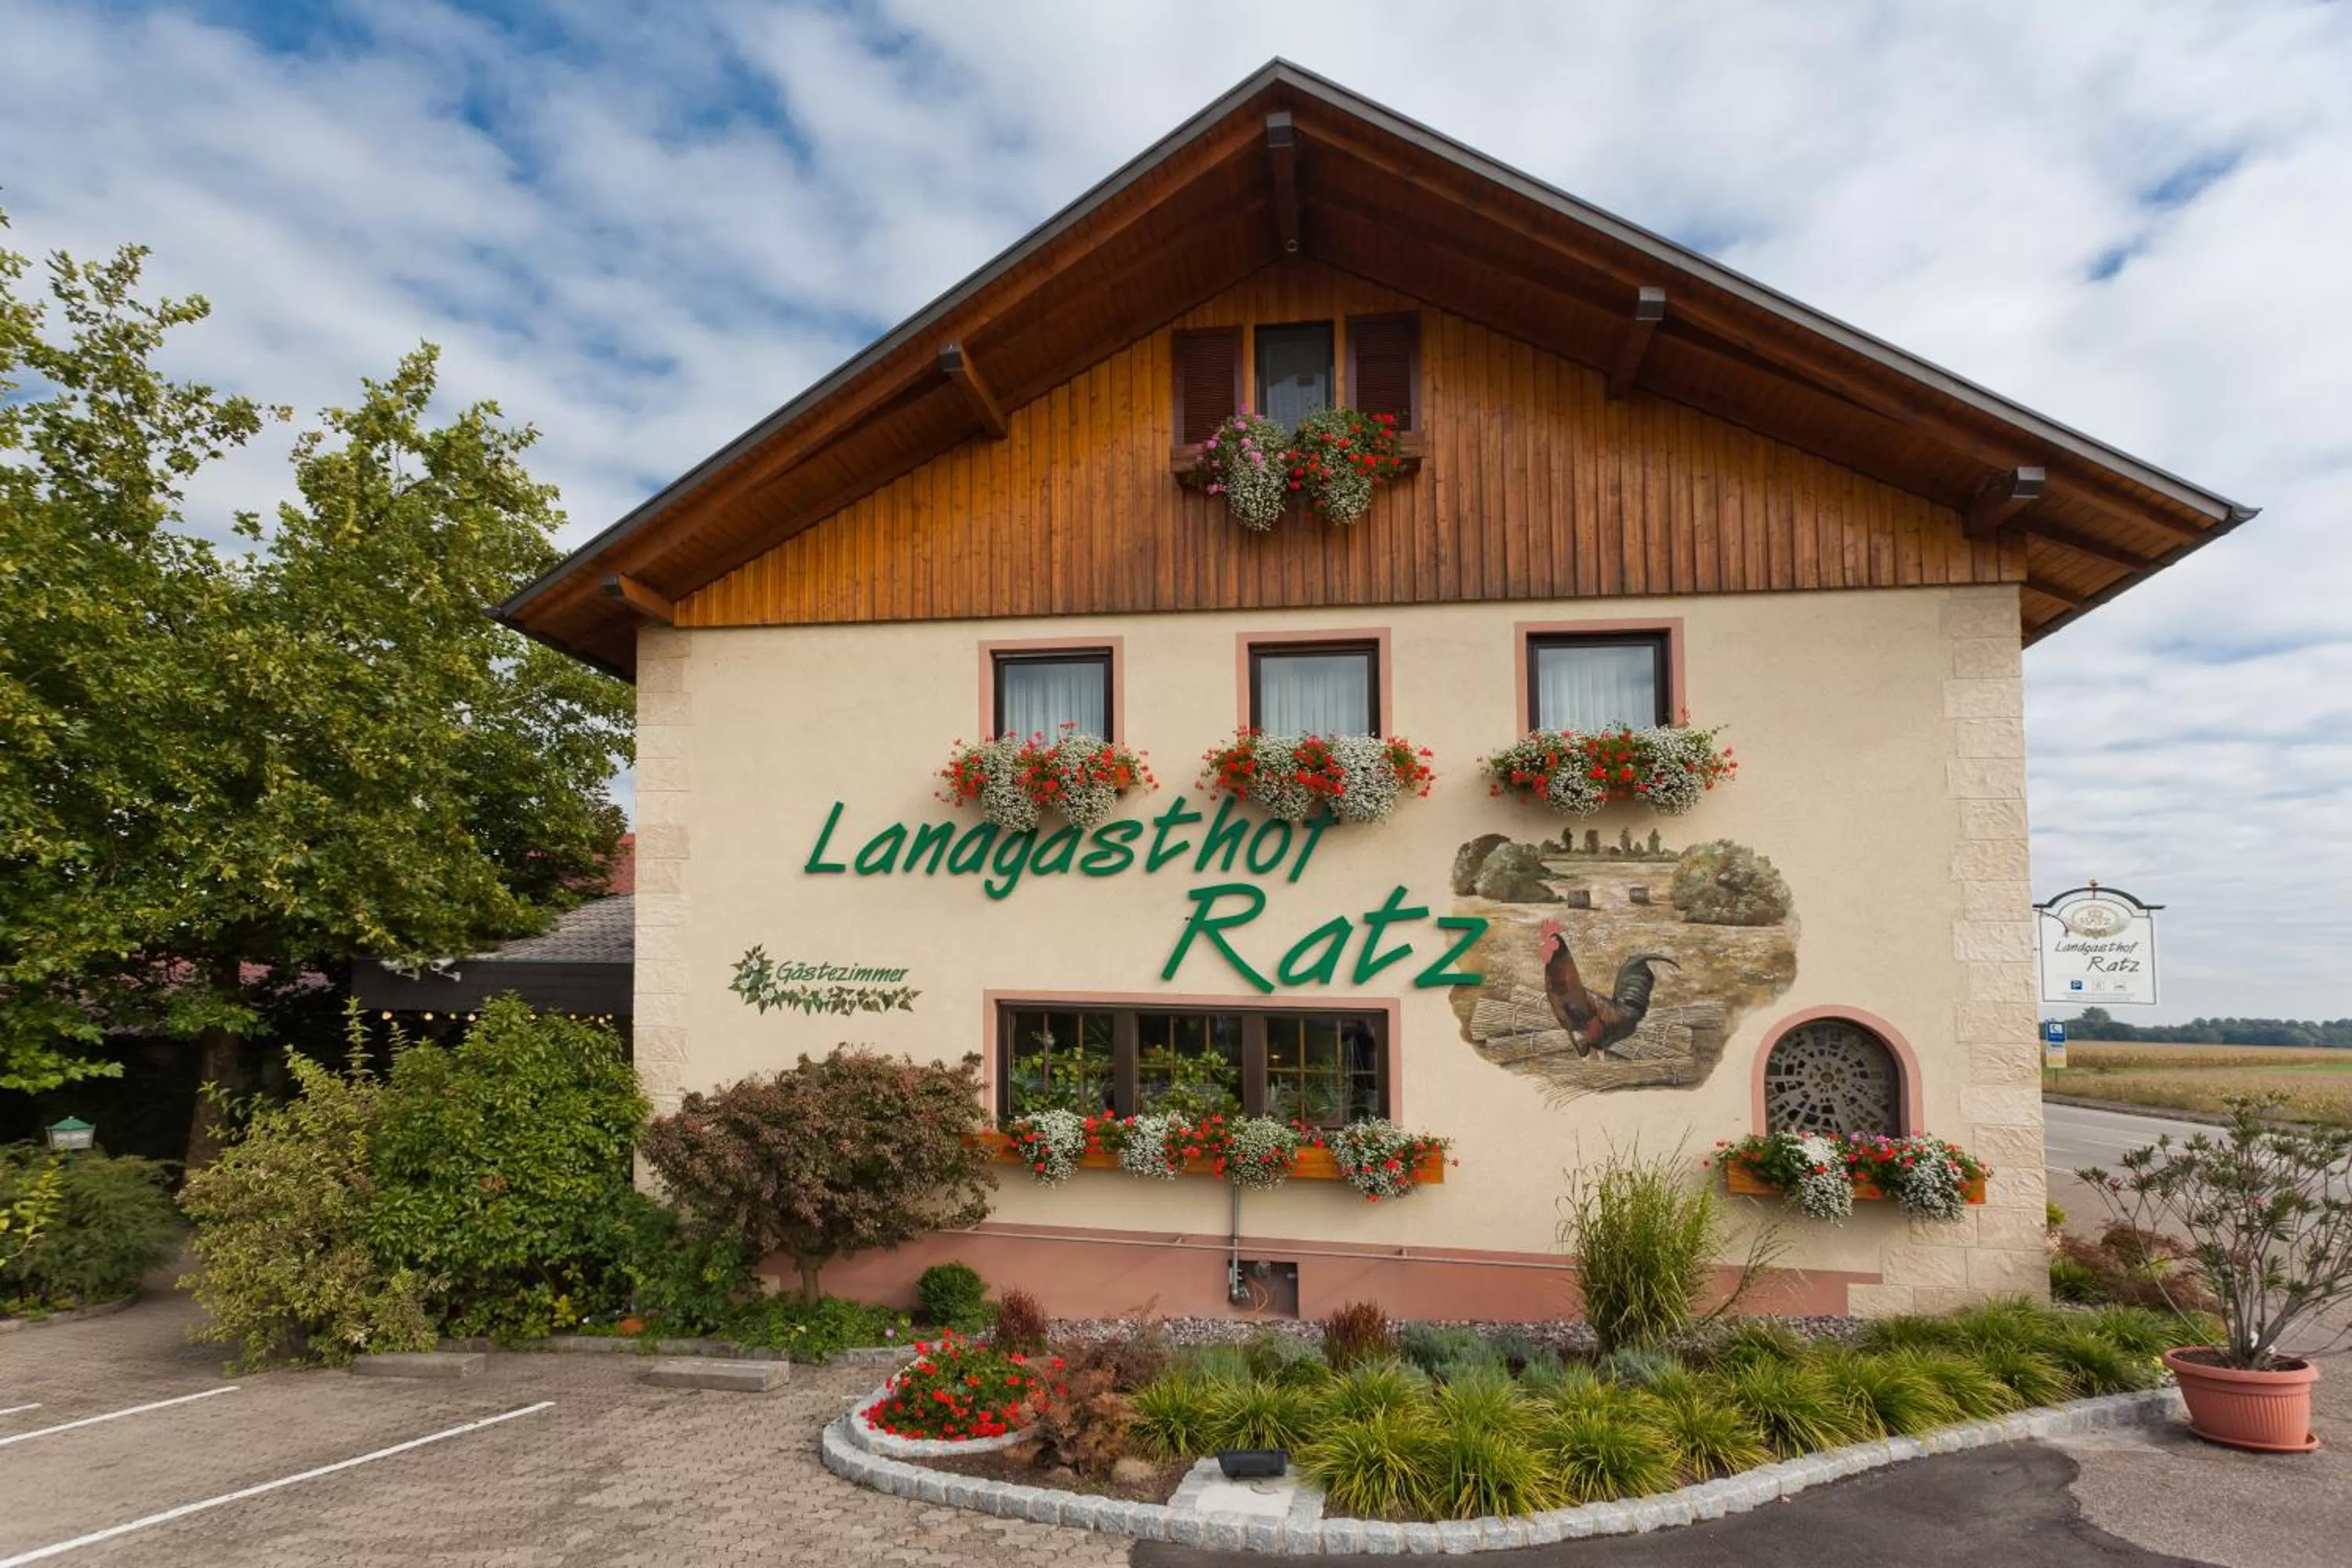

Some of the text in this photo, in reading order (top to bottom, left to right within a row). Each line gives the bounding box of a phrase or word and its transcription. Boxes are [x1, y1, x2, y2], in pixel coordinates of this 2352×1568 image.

[1162, 883, 1489, 993] Ratz
[2055, 941, 2138, 955] Landgasthof
[776, 960, 909, 983] Gästezimmer
[2087, 956, 2140, 972] Ratz
